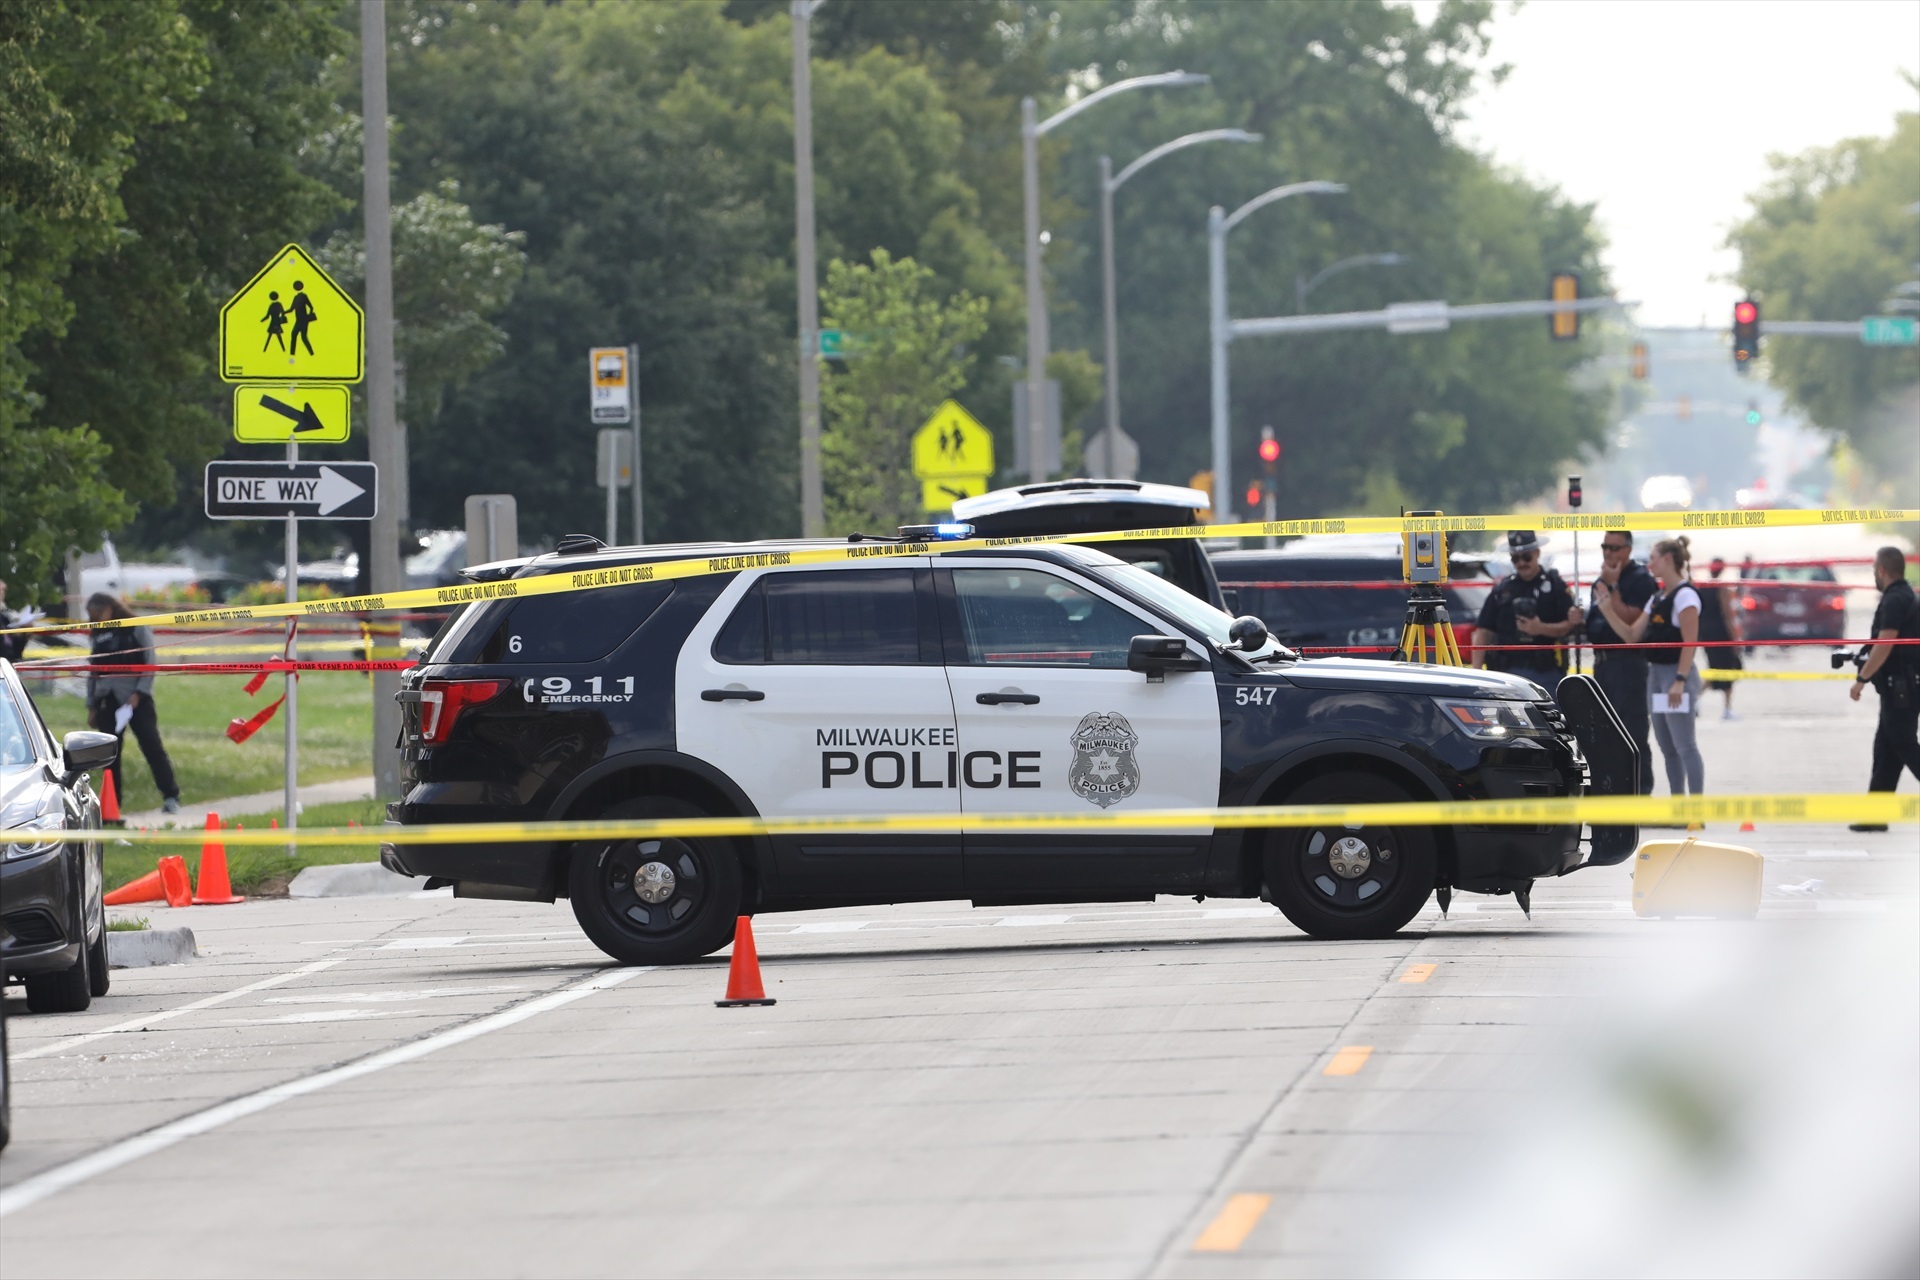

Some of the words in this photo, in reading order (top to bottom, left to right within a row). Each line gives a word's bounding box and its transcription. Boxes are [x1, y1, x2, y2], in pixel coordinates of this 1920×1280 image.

[222, 480, 265, 500] ONE
[278, 481, 318, 500] WAY
[847, 547, 868, 557] POLICE
[870, 545, 883, 555] LINE
[885, 544, 893, 554] DO
[894, 544, 907, 553] NOT
[908, 543, 929, 552] CROSS
[709, 558, 730, 571] POLICE
[731, 556, 745, 569] LINE
[746, 555, 755, 567] DO
[756, 553, 769, 566] NOT
[770, 552, 791, 565] CROSS
[572, 573, 594, 588] POLICE
[594, 571, 608, 585] LINE
[609, 570, 618, 583] DO
[619, 568, 632, 582] NOT
[633, 566, 654, 581] CROSS
[437, 589, 459, 602] POLICE
[460, 587, 474, 600] LINE
[474, 586, 483, 598] DO
[483, 585, 496, 598] NOT
[497, 582, 518, 596] CROSS
[305, 602, 326, 614] POLICE
[326, 601, 341, 612] LINE
[341, 600, 350, 611] DO
[350, 599, 364, 610] NOT
[364, 597, 385, 609] CROSS
[1357, 627, 1396, 642] 91
[508, 635, 523, 653] 6
[541, 676, 634, 695] 911
[541, 694, 633, 703] EMERGENCY
[1235, 687, 1277, 706] 547
[816, 728, 955, 746] MILWAUKEE
[1079, 739, 1130, 751] MILWAUKEE
[822, 750, 1041, 789] POLICE
[1081, 780, 1126, 793] POLICE
